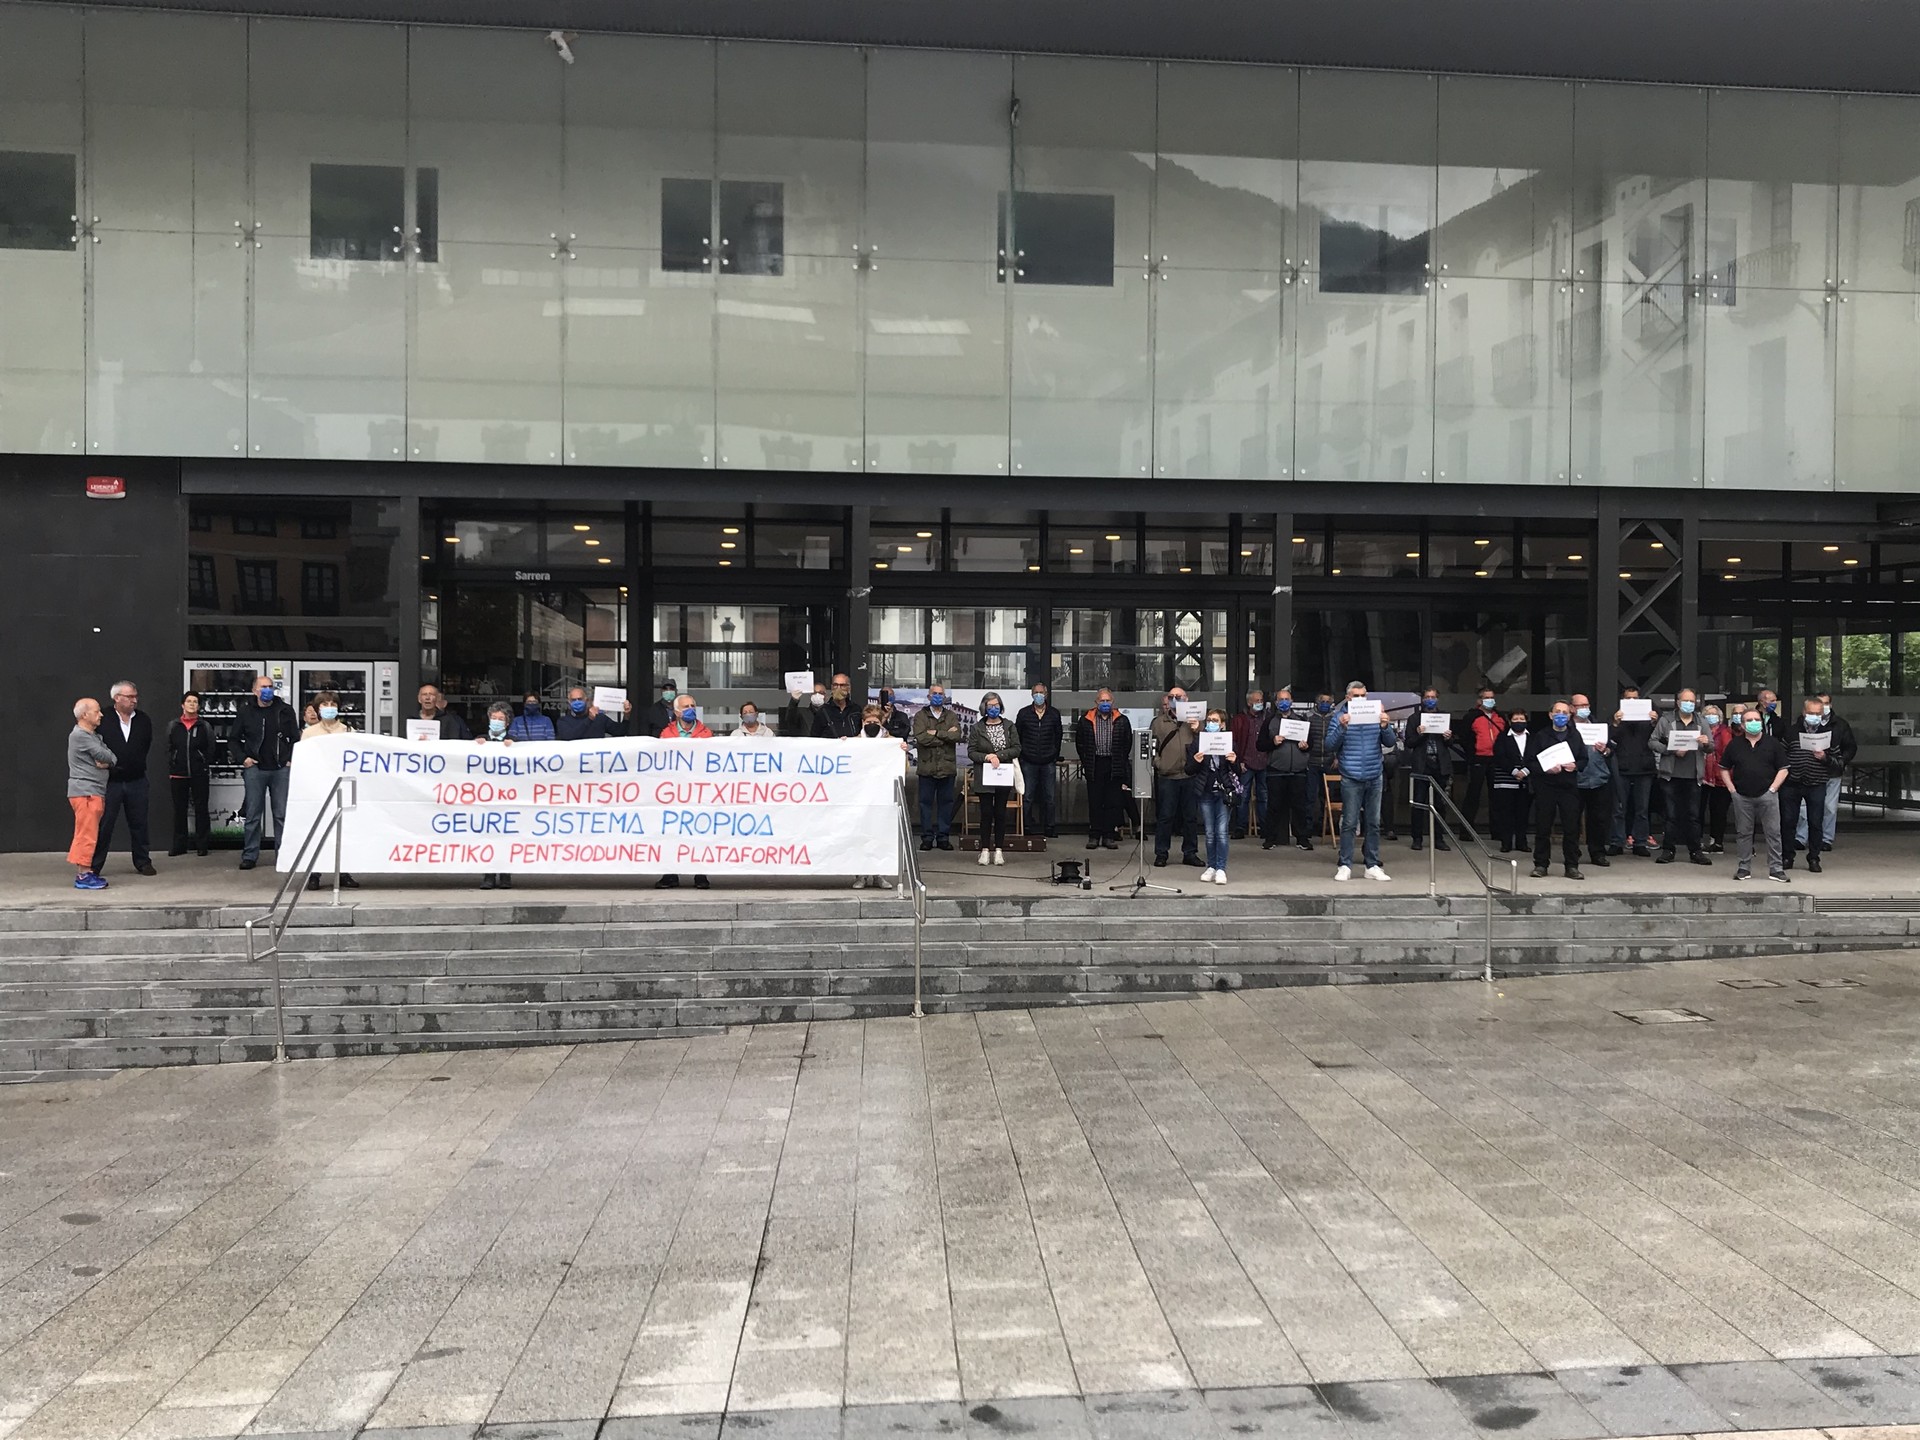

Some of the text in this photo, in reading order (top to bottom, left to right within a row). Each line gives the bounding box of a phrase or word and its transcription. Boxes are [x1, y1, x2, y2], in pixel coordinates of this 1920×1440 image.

[515, 570, 551, 581] Sarrera
[342, 750, 852, 776] PENTSIO PUBLIKO ETA DUIN BATEN AIDE
[533, 782, 640, 805] PENTSIO
[655, 781, 829, 804] GUTXIENGOA
[431, 810, 774, 836] GEURE SISTEMA PROPIOA
[389, 843, 812, 865] AZPEITIKO PENTSIODUNEN PLATAFORMA
